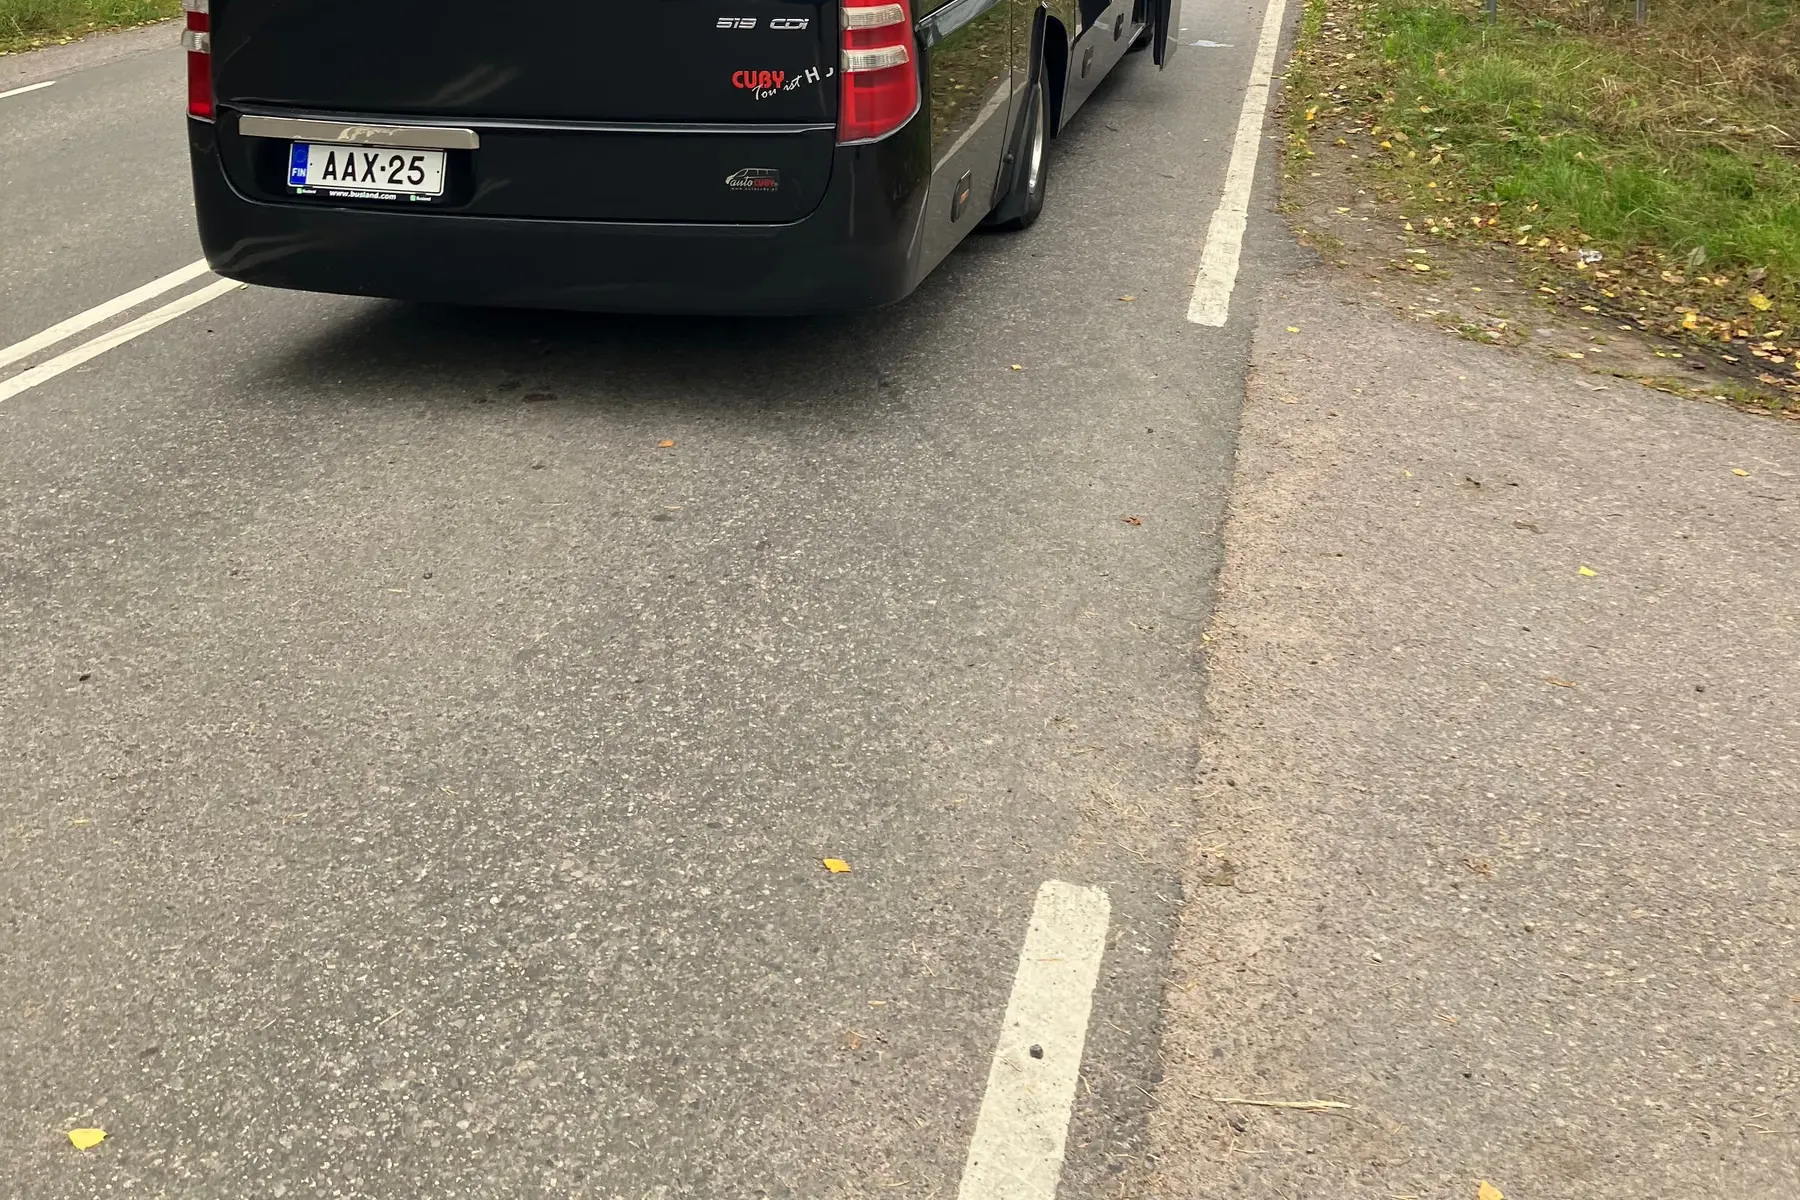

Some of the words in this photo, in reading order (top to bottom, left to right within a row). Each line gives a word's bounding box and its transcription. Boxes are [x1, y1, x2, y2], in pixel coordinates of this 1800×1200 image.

[716, 17, 757, 29] 519
[731, 70, 785, 89] CUBY
[751, 74, 802, 100] Touist
[291, 167, 306, 178] FIN
[321, 150, 426, 186] AAX-25
[329, 189, 397, 200] www.busland.com
